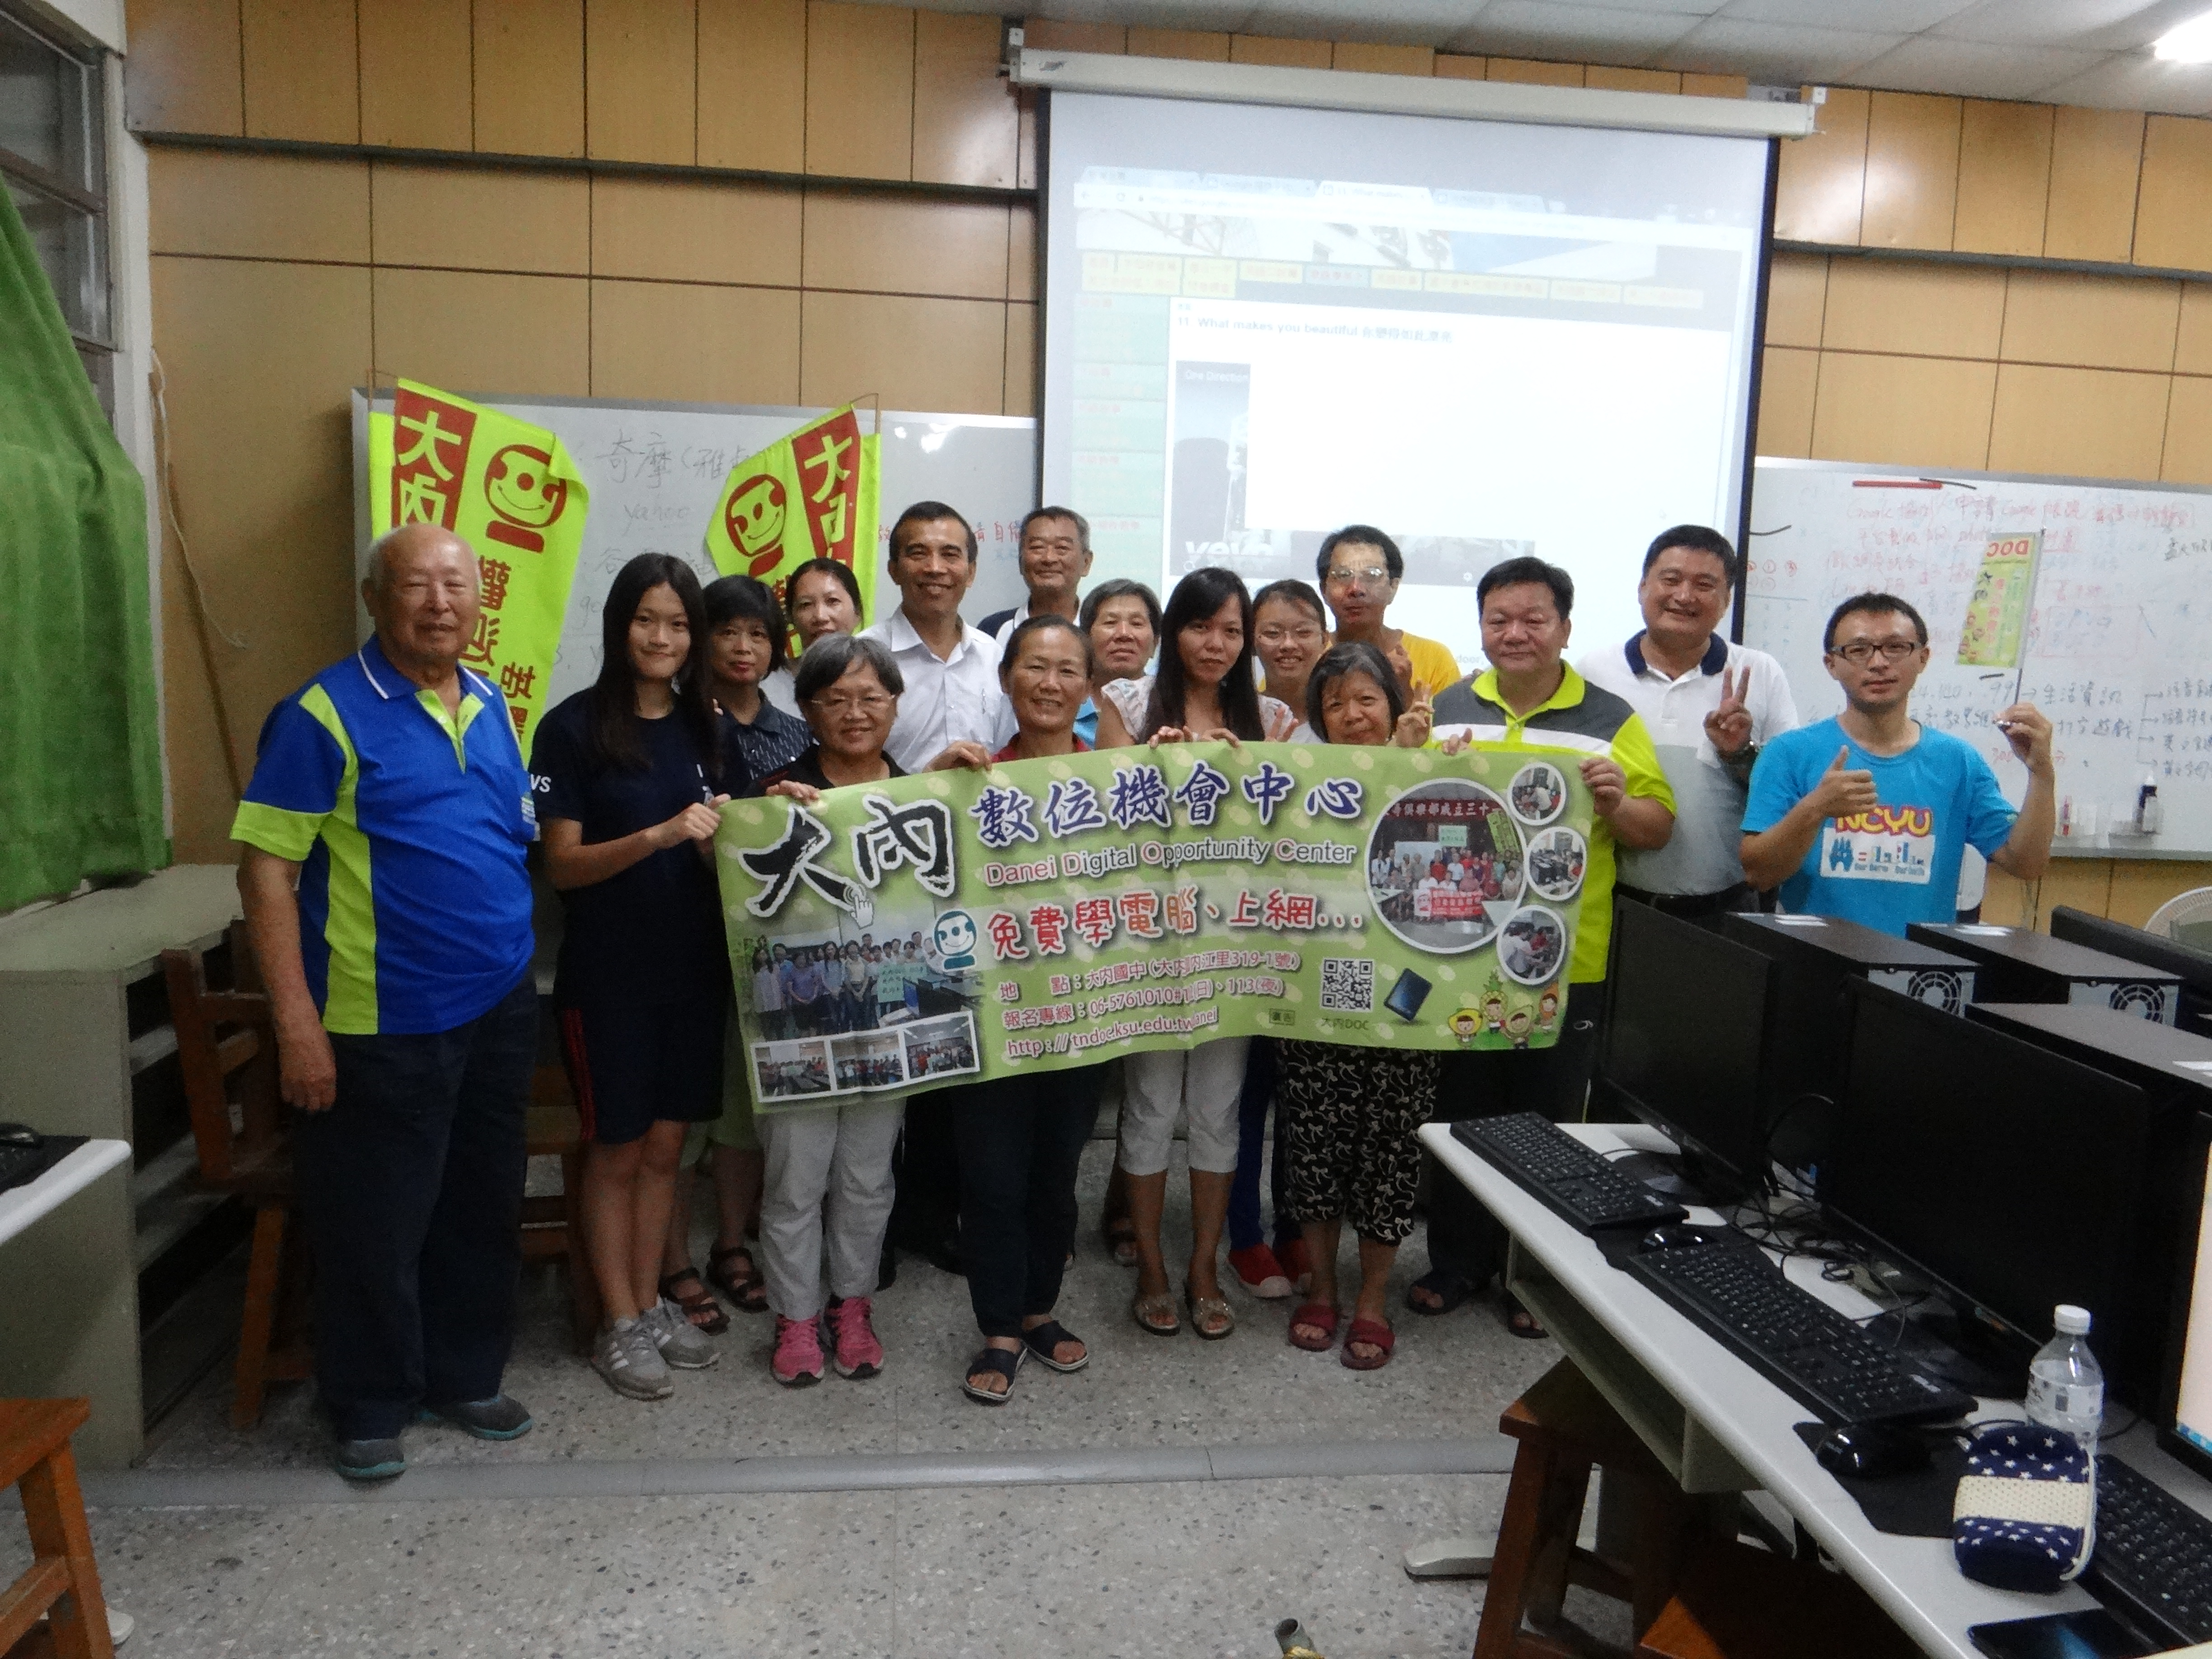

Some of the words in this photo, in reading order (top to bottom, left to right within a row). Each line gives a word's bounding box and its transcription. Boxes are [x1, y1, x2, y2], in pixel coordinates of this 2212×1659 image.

[1197, 317, 1229, 328] What
[1233, 319, 1274, 331] makes
[1278, 324, 1301, 334] you
[1304, 323, 1358, 337] beautiful
[971, 763, 1360, 844] 數位機會中心
[1836, 805, 1932, 837] NCYU
[740, 798, 952, 914] 大內
[986, 856, 1056, 884] Danei
[1063, 844, 1135, 876] Digital
[1142, 837, 1269, 866] Opportunity
[1275, 839, 1356, 862] Center
